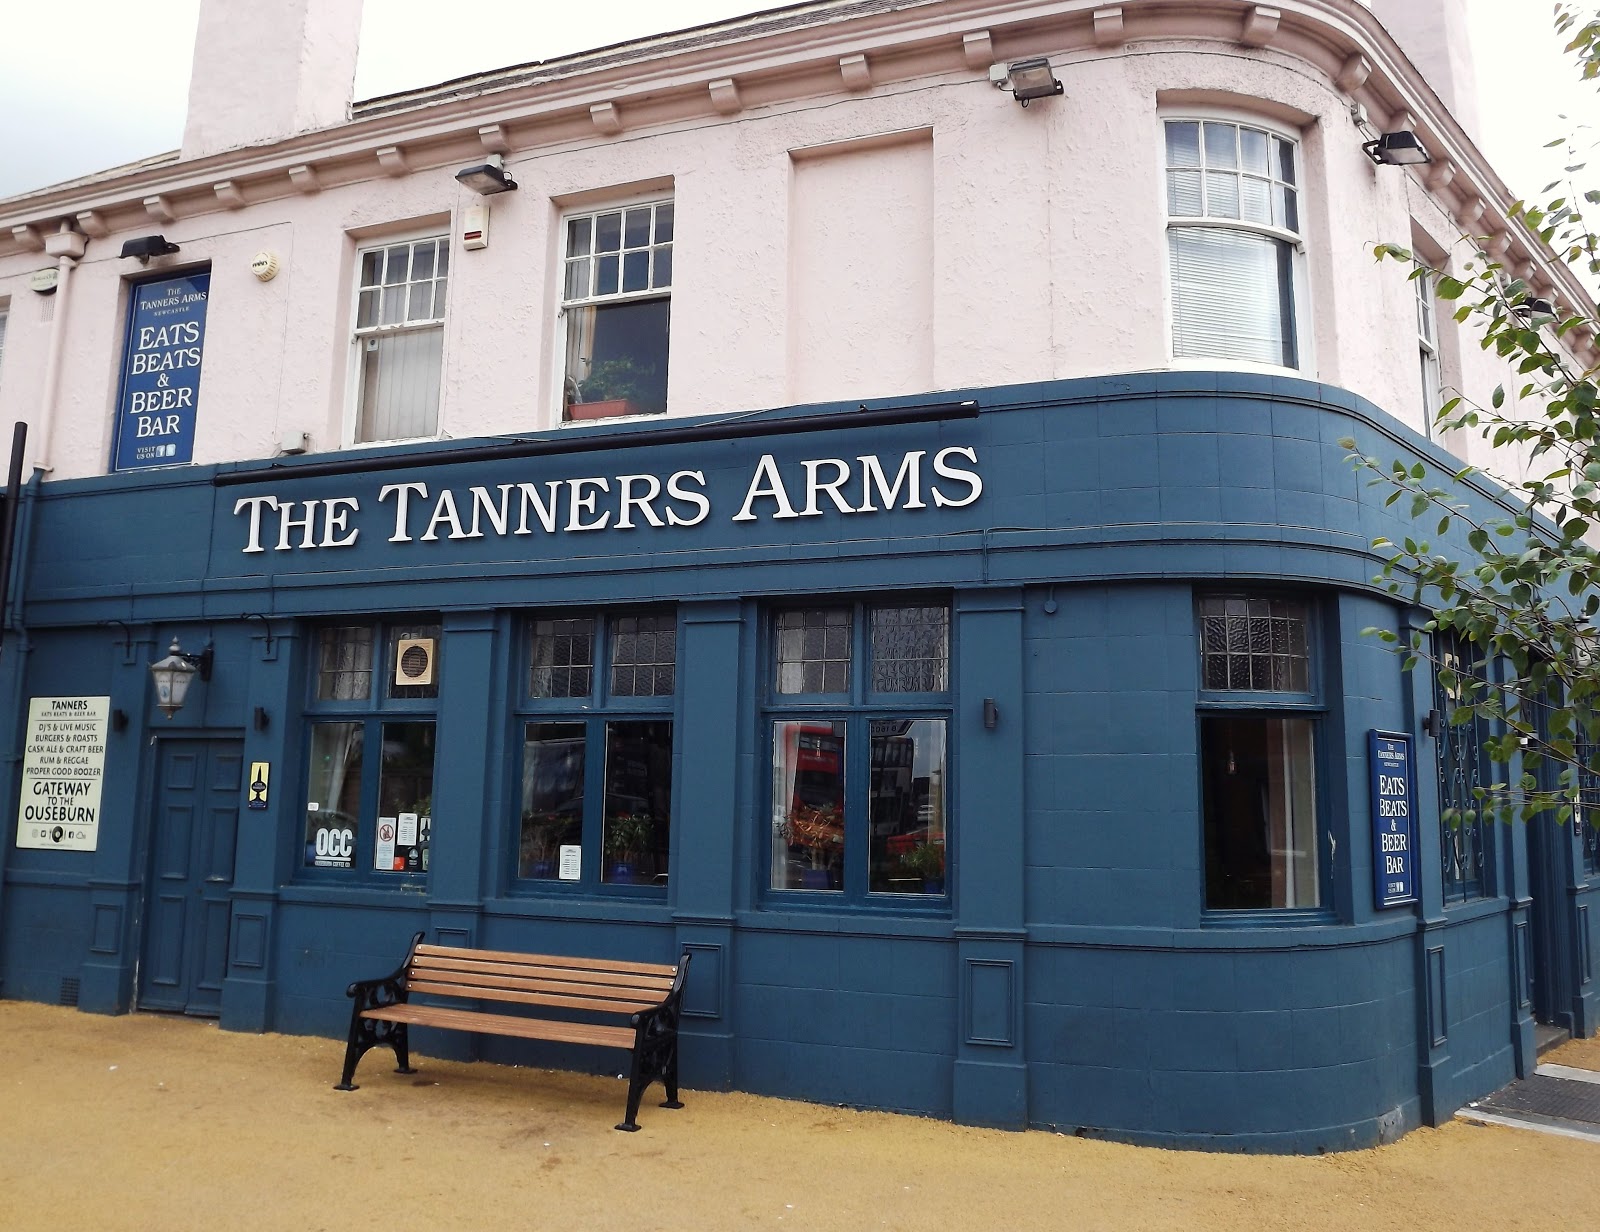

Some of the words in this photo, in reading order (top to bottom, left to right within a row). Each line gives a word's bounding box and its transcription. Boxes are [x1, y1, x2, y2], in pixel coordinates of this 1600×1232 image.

[168, 288, 181, 296] THE
[140, 297, 179, 310] TANNERS
[181, 292, 207, 303] ARMS
[154, 306, 190, 316] NEWCASTLE
[138, 321, 200, 351] EATS
[131, 347, 201, 375] BEATS
[157, 373, 169, 387] &
[130, 387, 192, 414] BEER
[136, 415, 180, 438] BAR
[137, 446, 156, 454] VISIT
[233, 495, 360, 553] THE
[378, 470, 707, 543] TANNERS
[731, 446, 984, 521] ARMS
[52, 700, 88, 710] TANNERS
[35, 734, 64, 742] BURGERS
[66, 734, 71, 742] &
[73, 734, 98, 742] ROASTS
[28, 745, 44, 753] CASK
[46, 745, 57, 753] ALE
[59, 745, 64, 753] &
[66, 745, 86, 753] CRAFT
[88, 745, 103, 753] BEER
[26, 767, 50, 775] PROPER
[52, 767, 72, 775] GOOD
[74, 767, 100, 775] BOOZER
[33, 782, 91, 796] GATEWAY
[1380, 775, 1405, 795] EATS
[48, 796, 57, 805] TO
[60, 797, 74, 806] THE
[1380, 799, 1407, 817] BEATS
[25, 805, 95, 822] OUSEBURN
[1391, 819, 1396, 831] &
[316, 828, 352, 857] OCC
[1382, 833, 1407, 852] BEER
[1386, 856, 1404, 874] BAR
